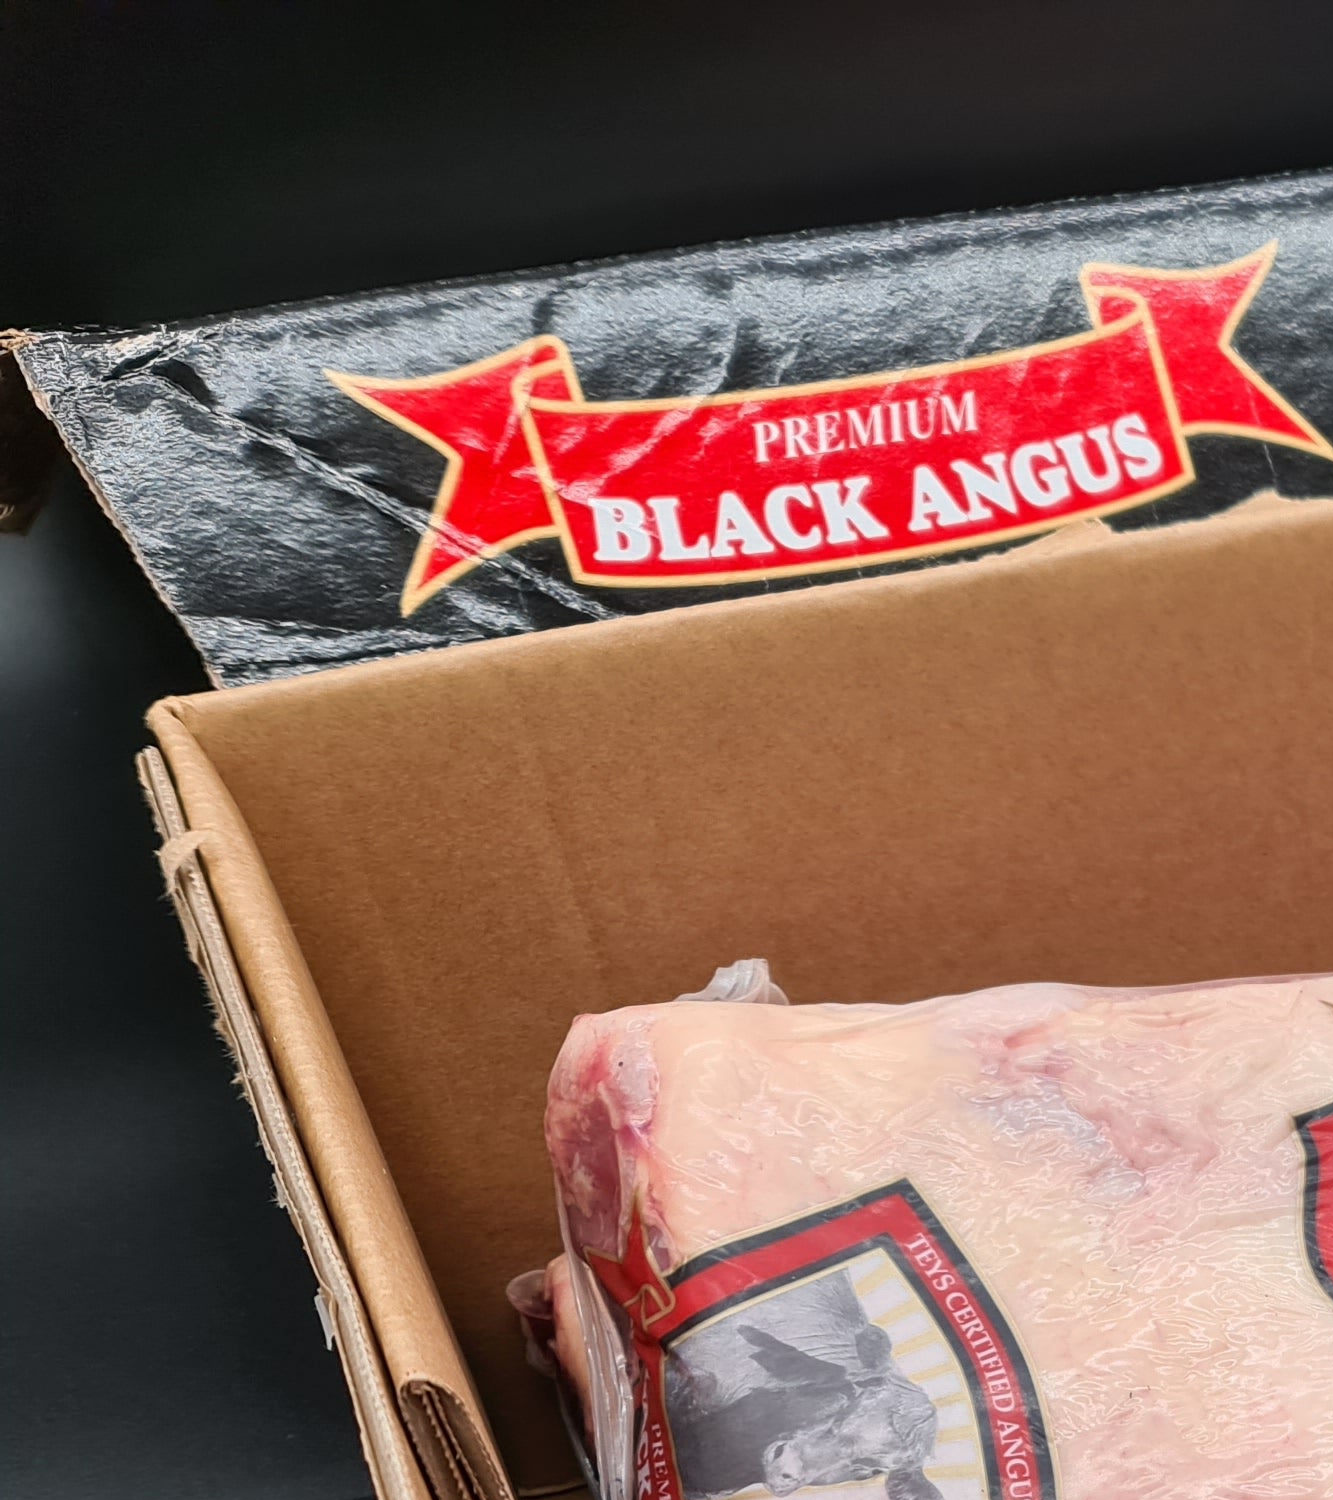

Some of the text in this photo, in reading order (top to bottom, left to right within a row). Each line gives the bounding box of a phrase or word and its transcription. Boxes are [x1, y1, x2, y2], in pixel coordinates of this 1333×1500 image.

[590, 411, 1163, 565] BLACK ANGUS
[752, 391, 979, 464] PREMIUM
[906, 1232, 955, 1292] TEYS
[946, 1291, 1015, 1413] CERTIFIED
